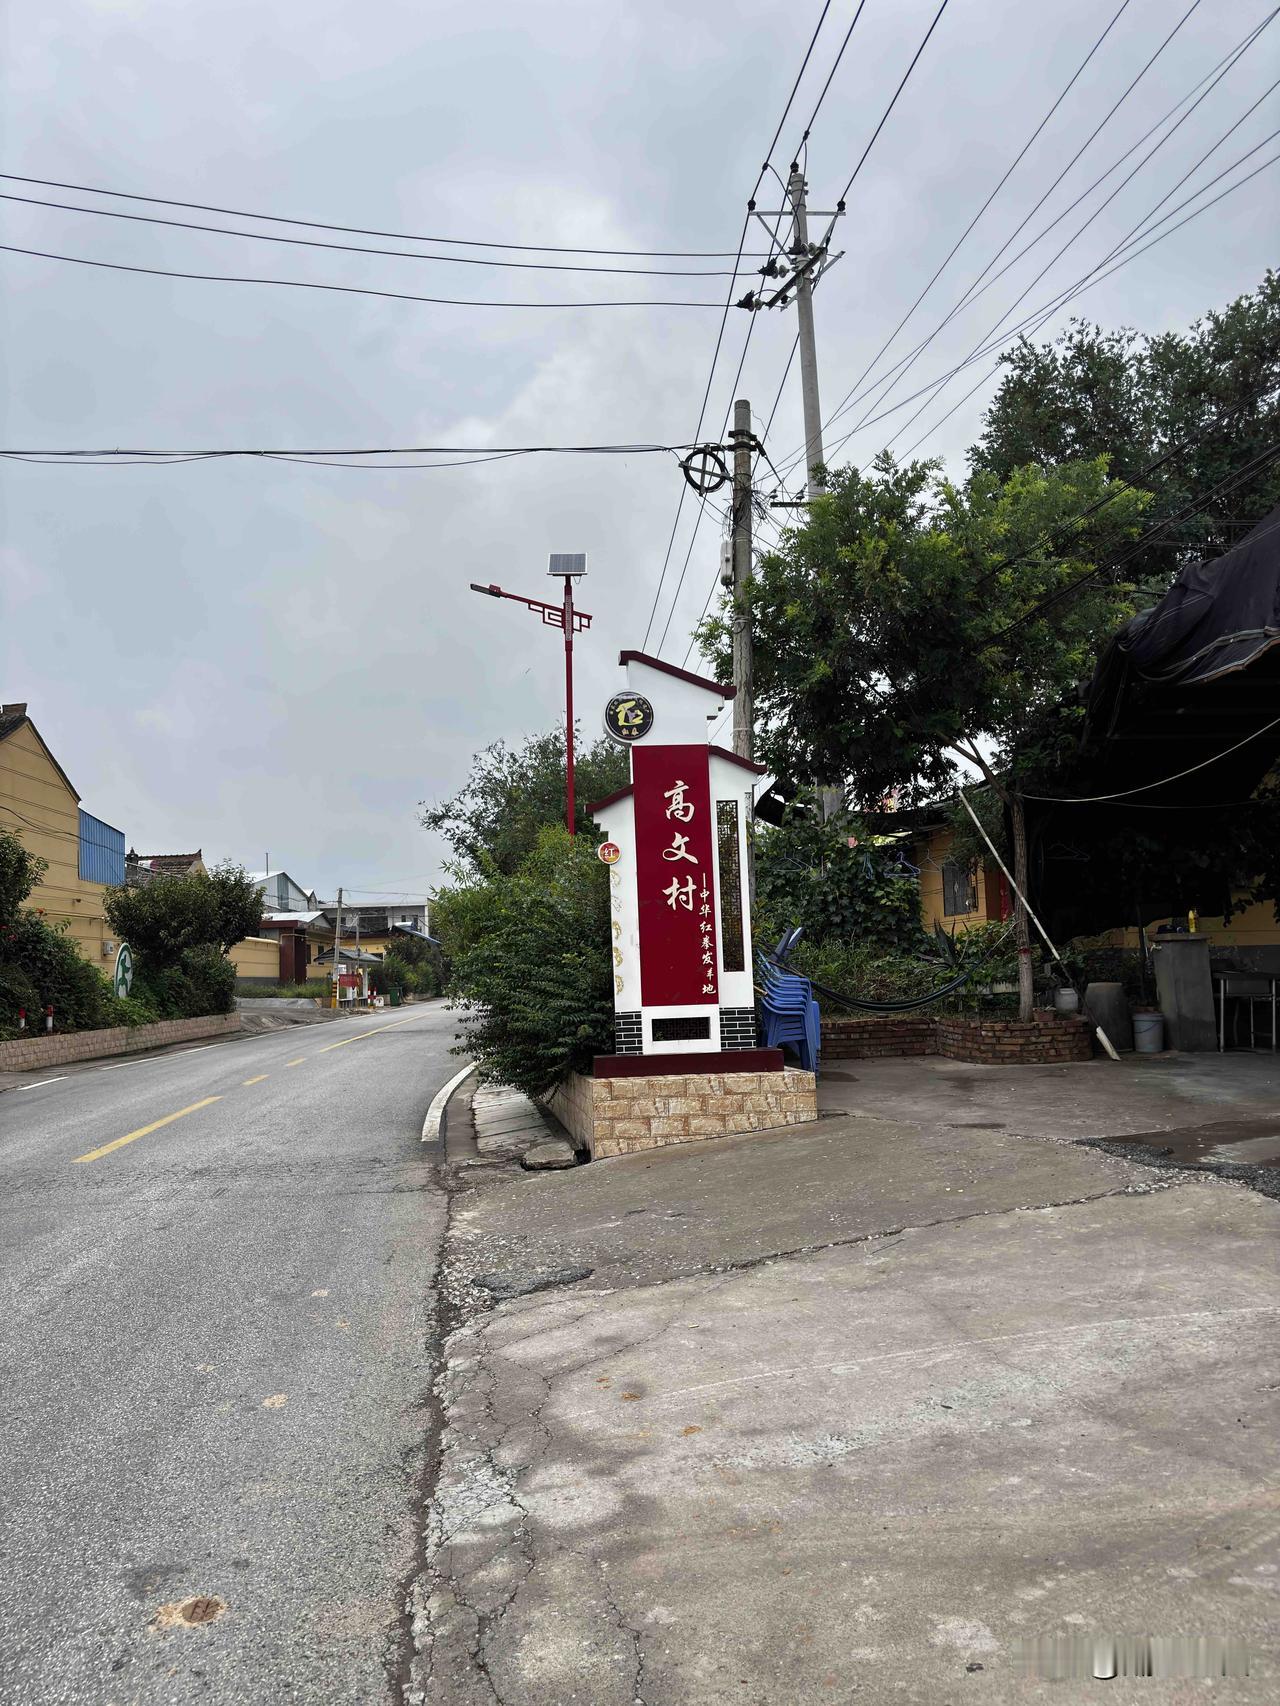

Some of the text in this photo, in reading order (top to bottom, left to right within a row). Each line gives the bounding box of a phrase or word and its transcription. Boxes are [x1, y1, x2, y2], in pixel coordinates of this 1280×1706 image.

[604, 847, 616, 859] 红
[662, 779, 699, 912] 高文村
